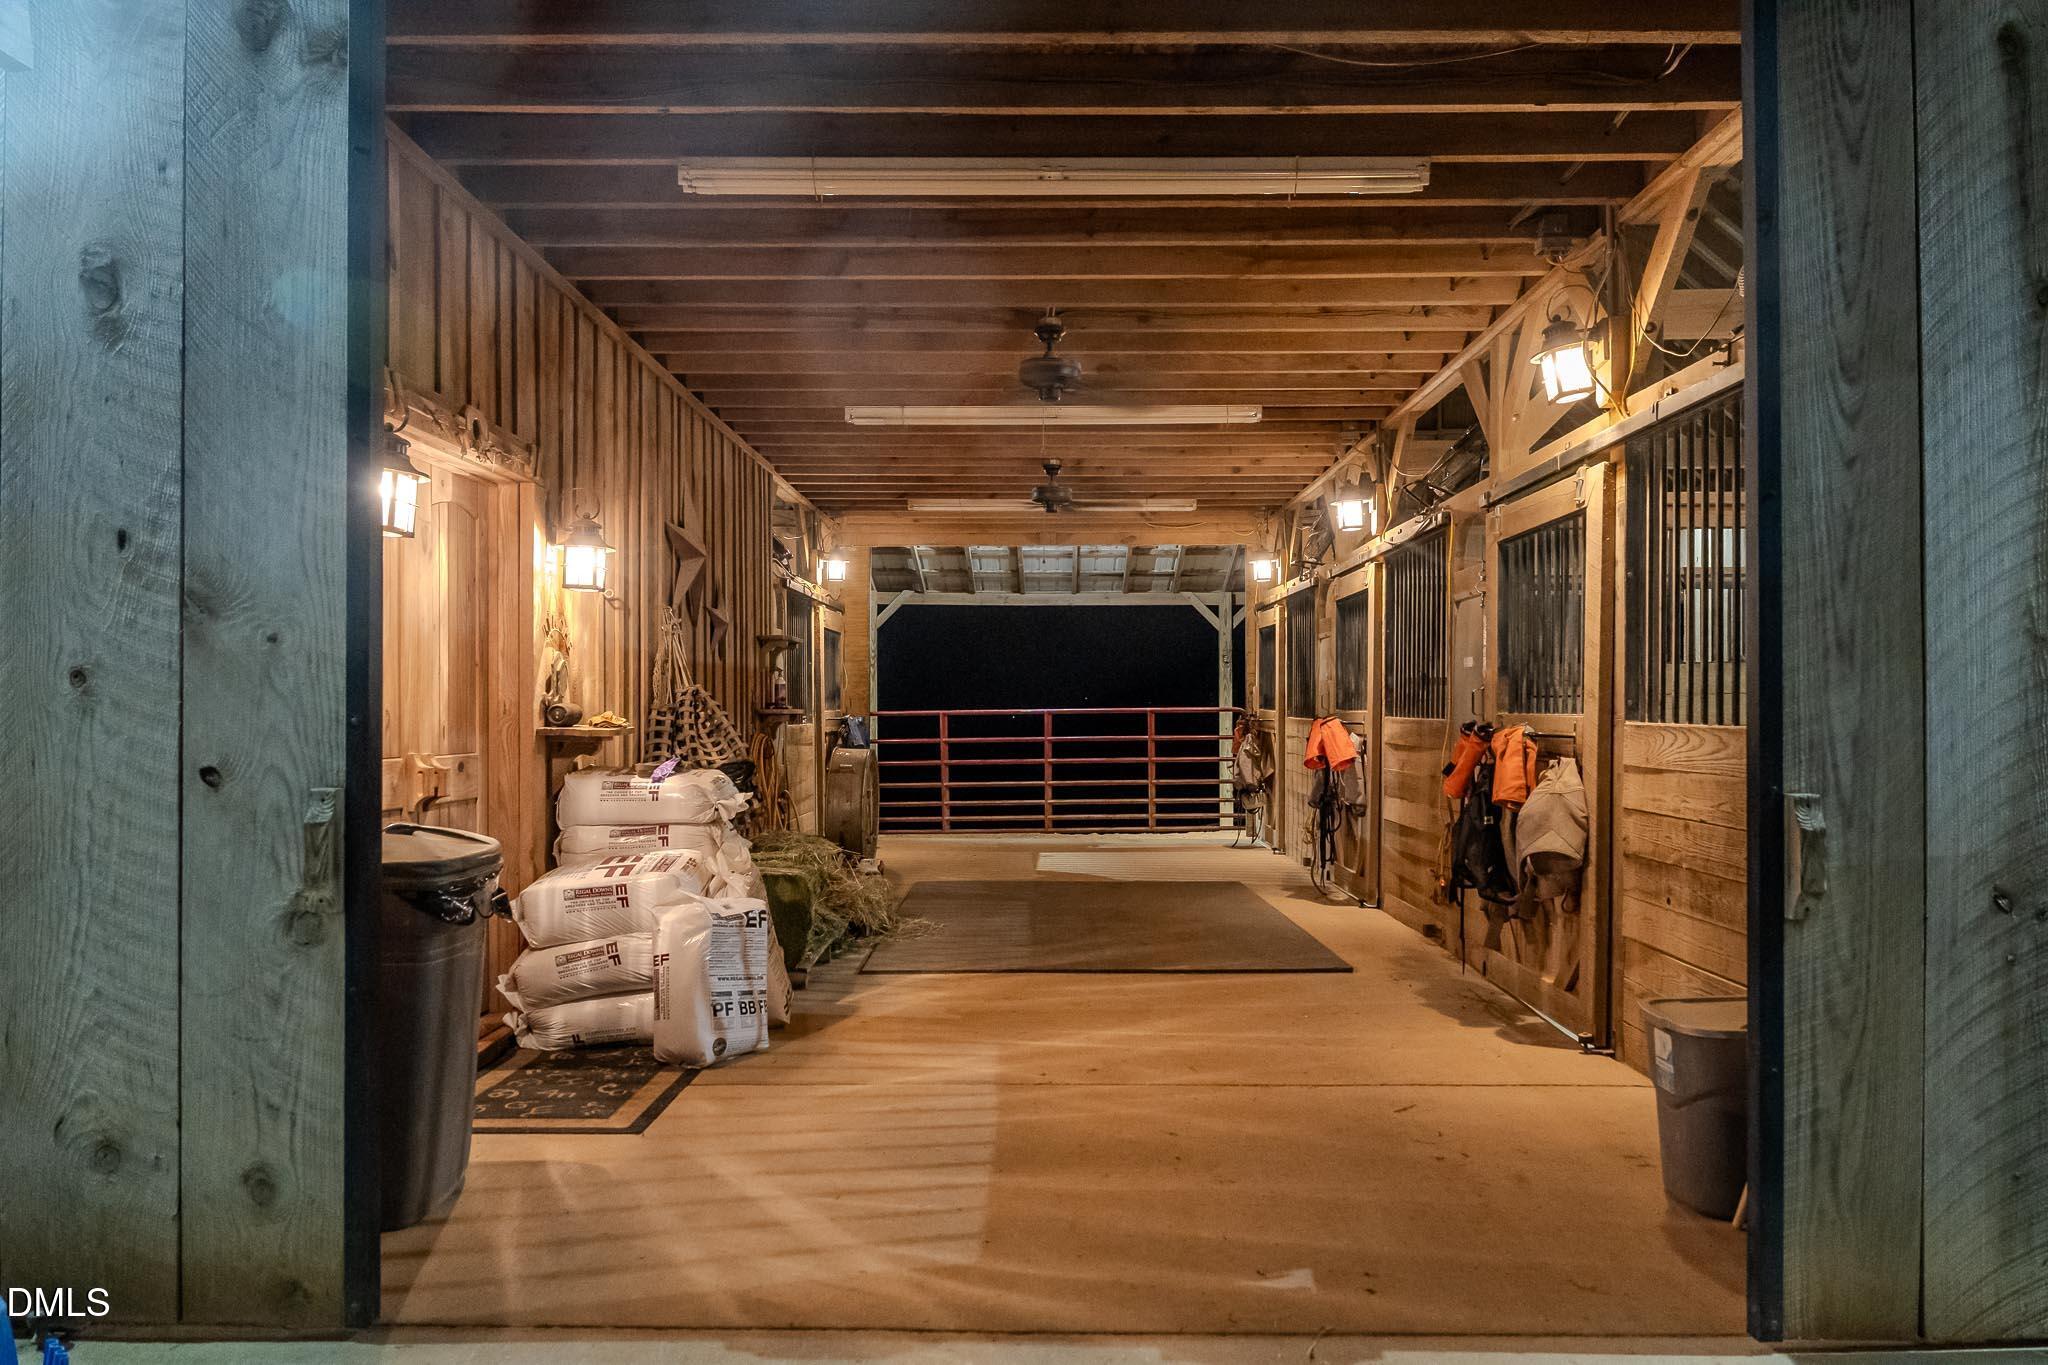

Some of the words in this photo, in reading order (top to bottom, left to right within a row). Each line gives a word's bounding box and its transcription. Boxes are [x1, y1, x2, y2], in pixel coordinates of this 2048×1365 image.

[615, 883, 630, 908] EF
[742, 909, 767, 929] EF
[606, 941, 622, 966] EF
[653, 953, 670, 967] EF
[712, 1001, 734, 1017] PF
[739, 1000, 757, 1016] BB
